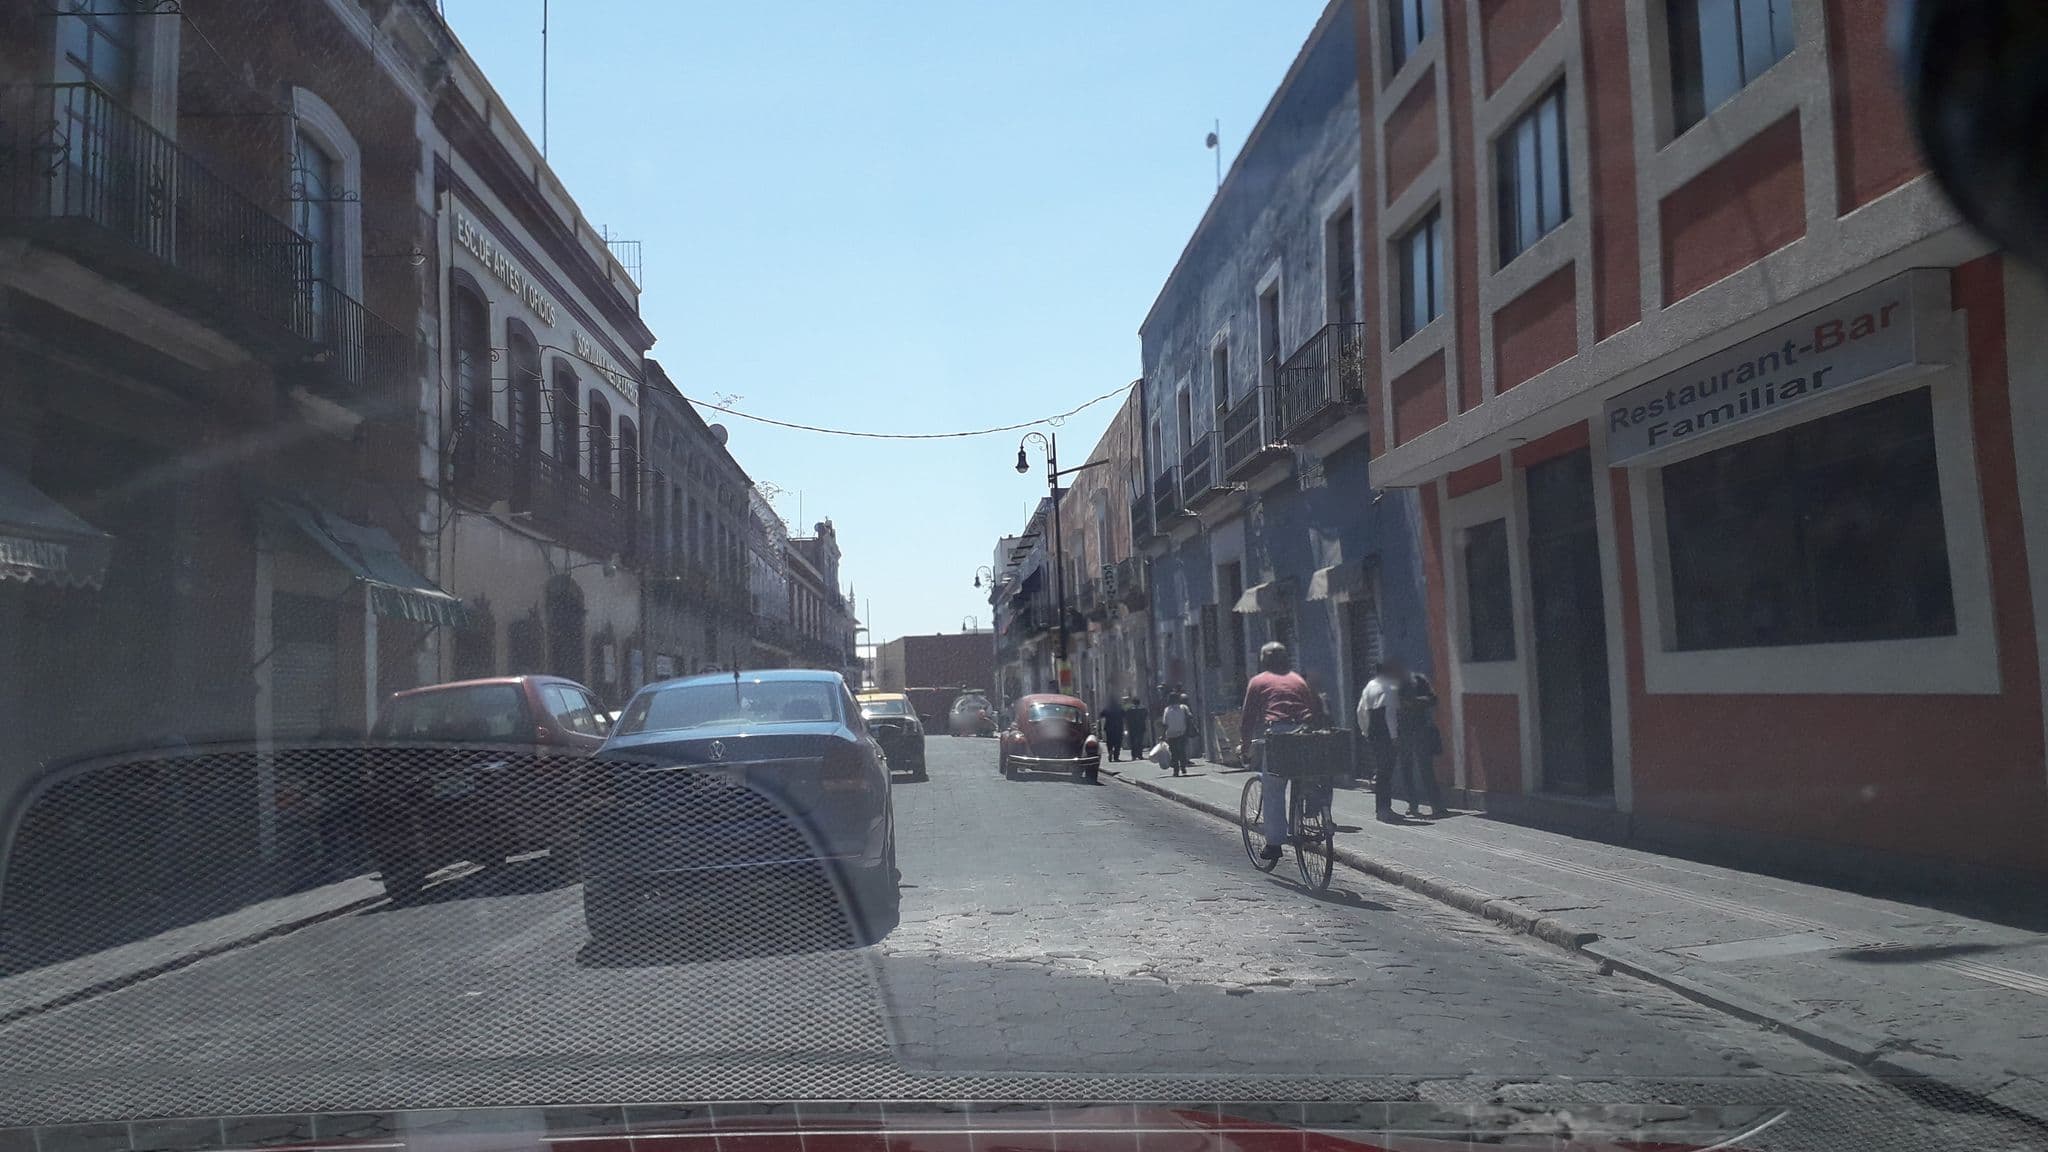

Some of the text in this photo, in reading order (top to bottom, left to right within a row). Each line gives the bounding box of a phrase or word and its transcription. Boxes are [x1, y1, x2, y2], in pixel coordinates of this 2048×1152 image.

[458, 213, 556, 329] ESC. DE ARTES Y OFICIOS
[1609, 302, 1900, 433] Restaurant-Bar
[1648, 365, 1833, 446] Familiar
